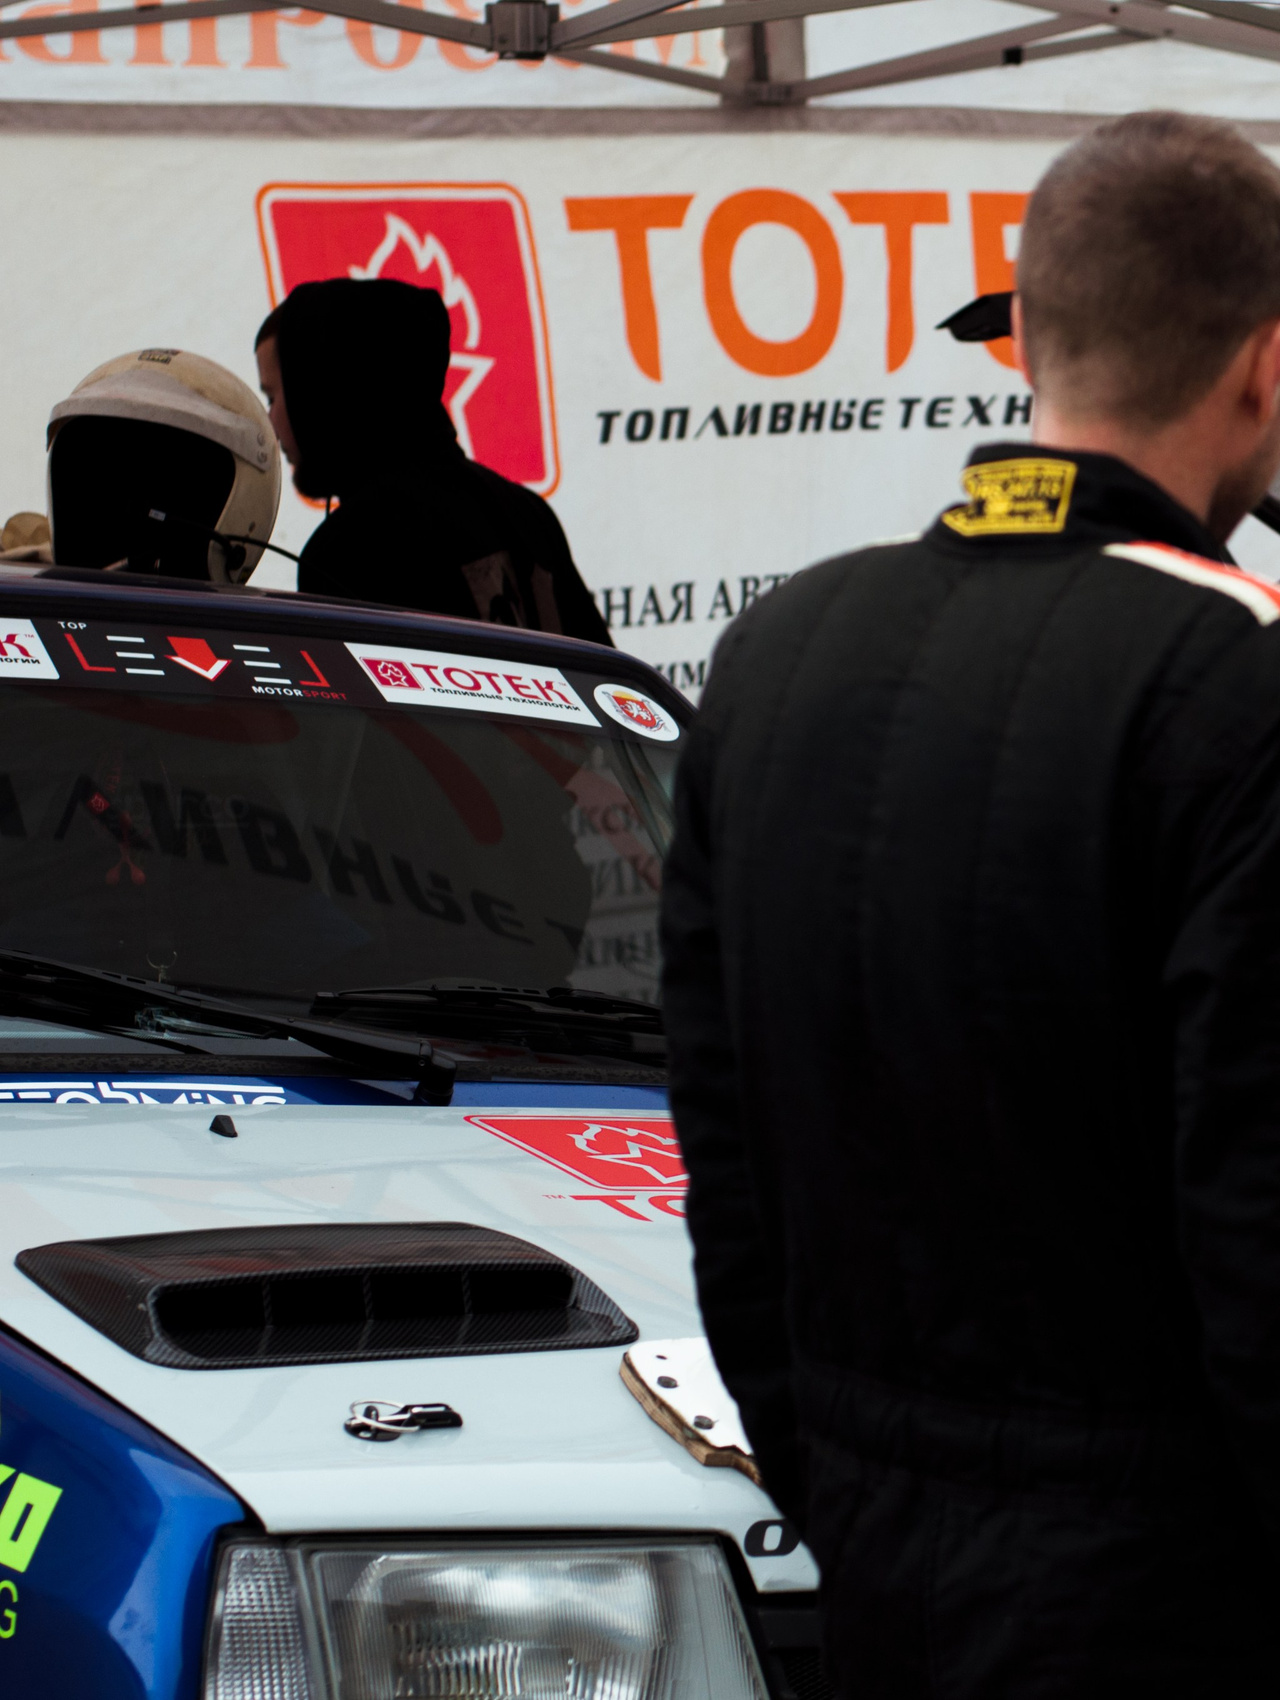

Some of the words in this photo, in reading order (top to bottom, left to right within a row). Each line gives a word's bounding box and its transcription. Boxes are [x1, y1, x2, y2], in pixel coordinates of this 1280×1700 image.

[597, 398, 885, 445] ТОПЛИВНЫЕ
[57, 621, 87, 630] TOP
[251, 686, 347, 701] MOTORSPORT
[411, 663, 574, 705] TOTEK
